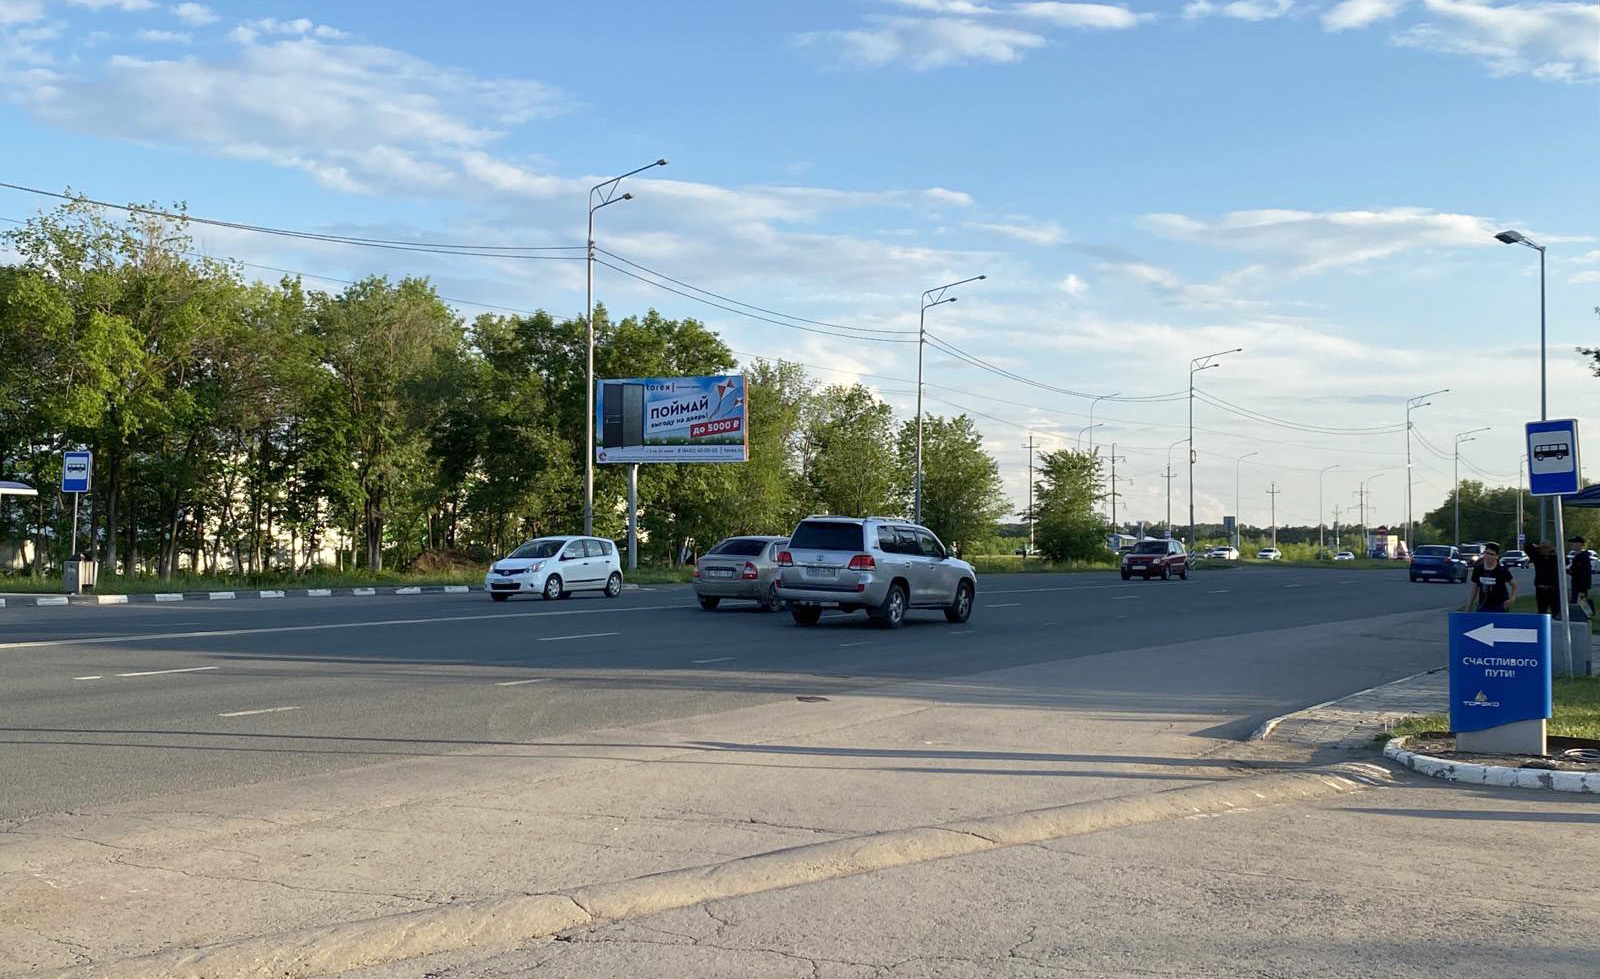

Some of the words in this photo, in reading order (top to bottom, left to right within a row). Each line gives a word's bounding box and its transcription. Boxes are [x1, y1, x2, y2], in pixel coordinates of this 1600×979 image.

[646, 383, 670, 391] torex
[651, 396, 709, 419] ПОЙМАЙ
[651, 420, 675, 428] выгоду
[685, 413, 708, 423] дверь!
[693, 426, 705, 435] до
[708, 421, 731, 431] 5000
[1463, 657, 1538, 667] СЧАСТЛИВОГО
[1485, 669, 1516, 677] ПУТИ!
